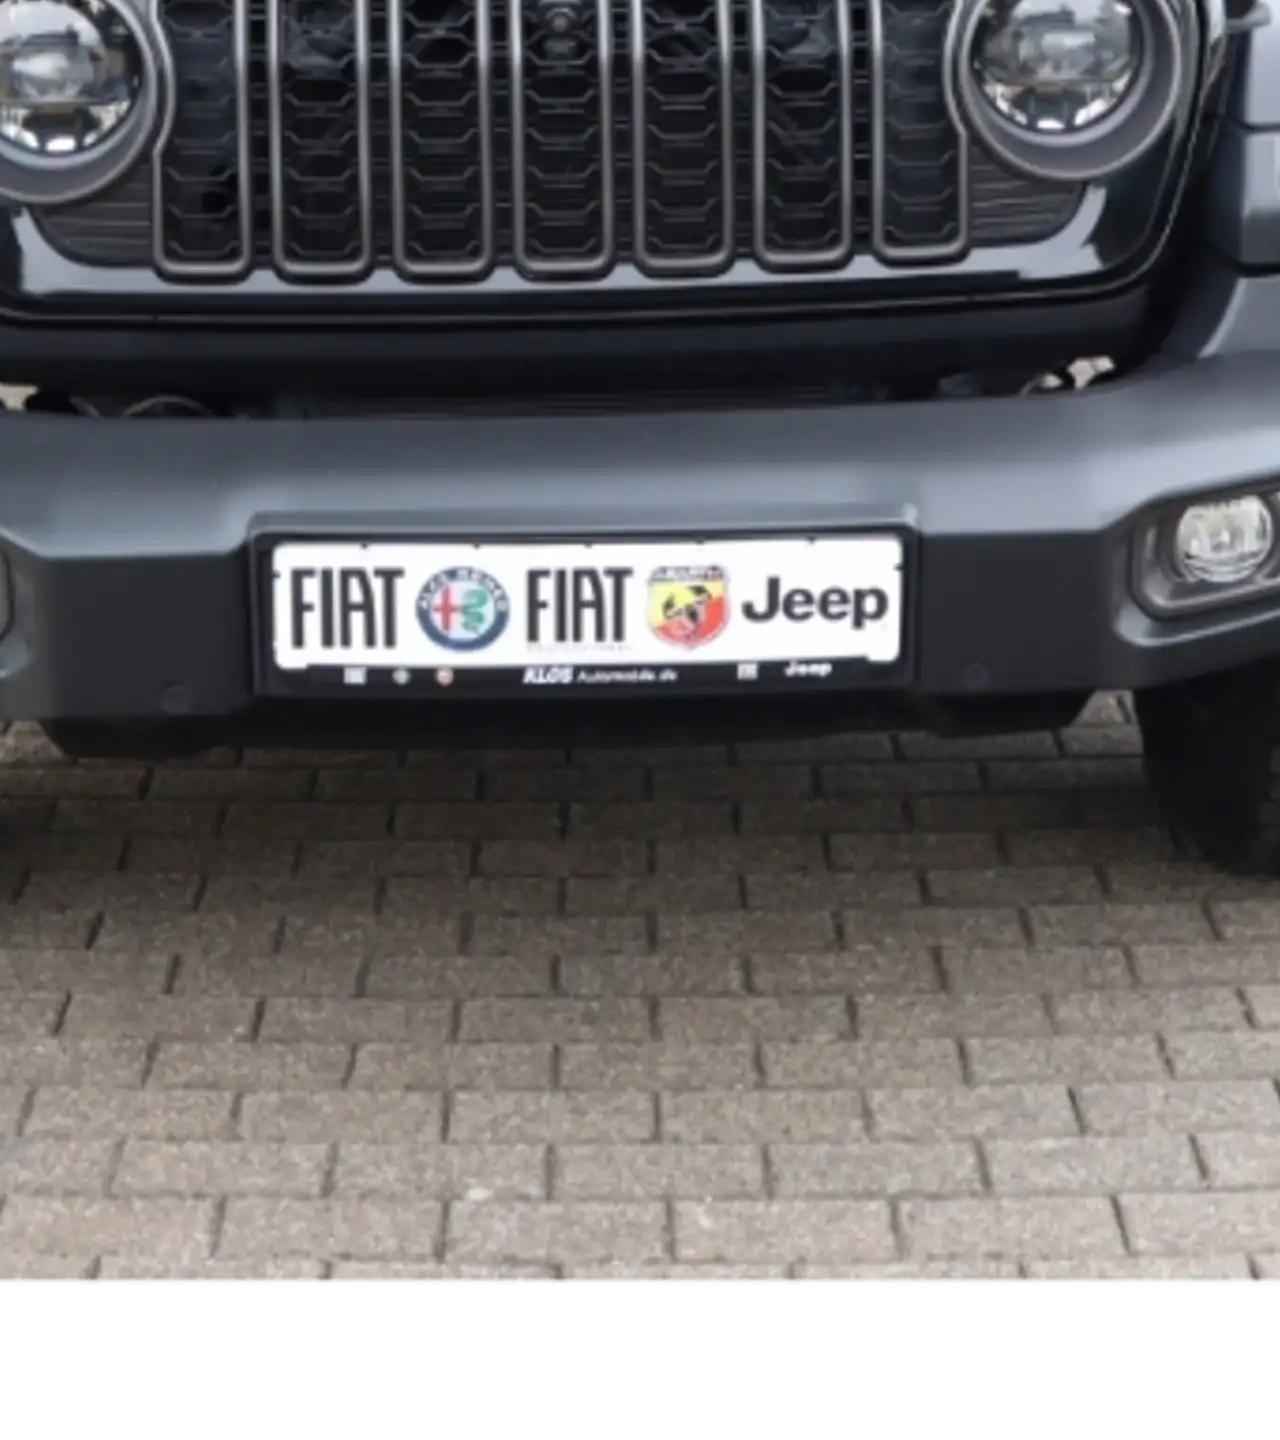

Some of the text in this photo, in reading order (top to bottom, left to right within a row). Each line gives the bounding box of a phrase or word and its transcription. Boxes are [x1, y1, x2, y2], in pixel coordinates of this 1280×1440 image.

[291, 566, 406, 649] FIAT
[526, 566, 634, 643] FIAT
[741, 575, 889, 630] Jeep
